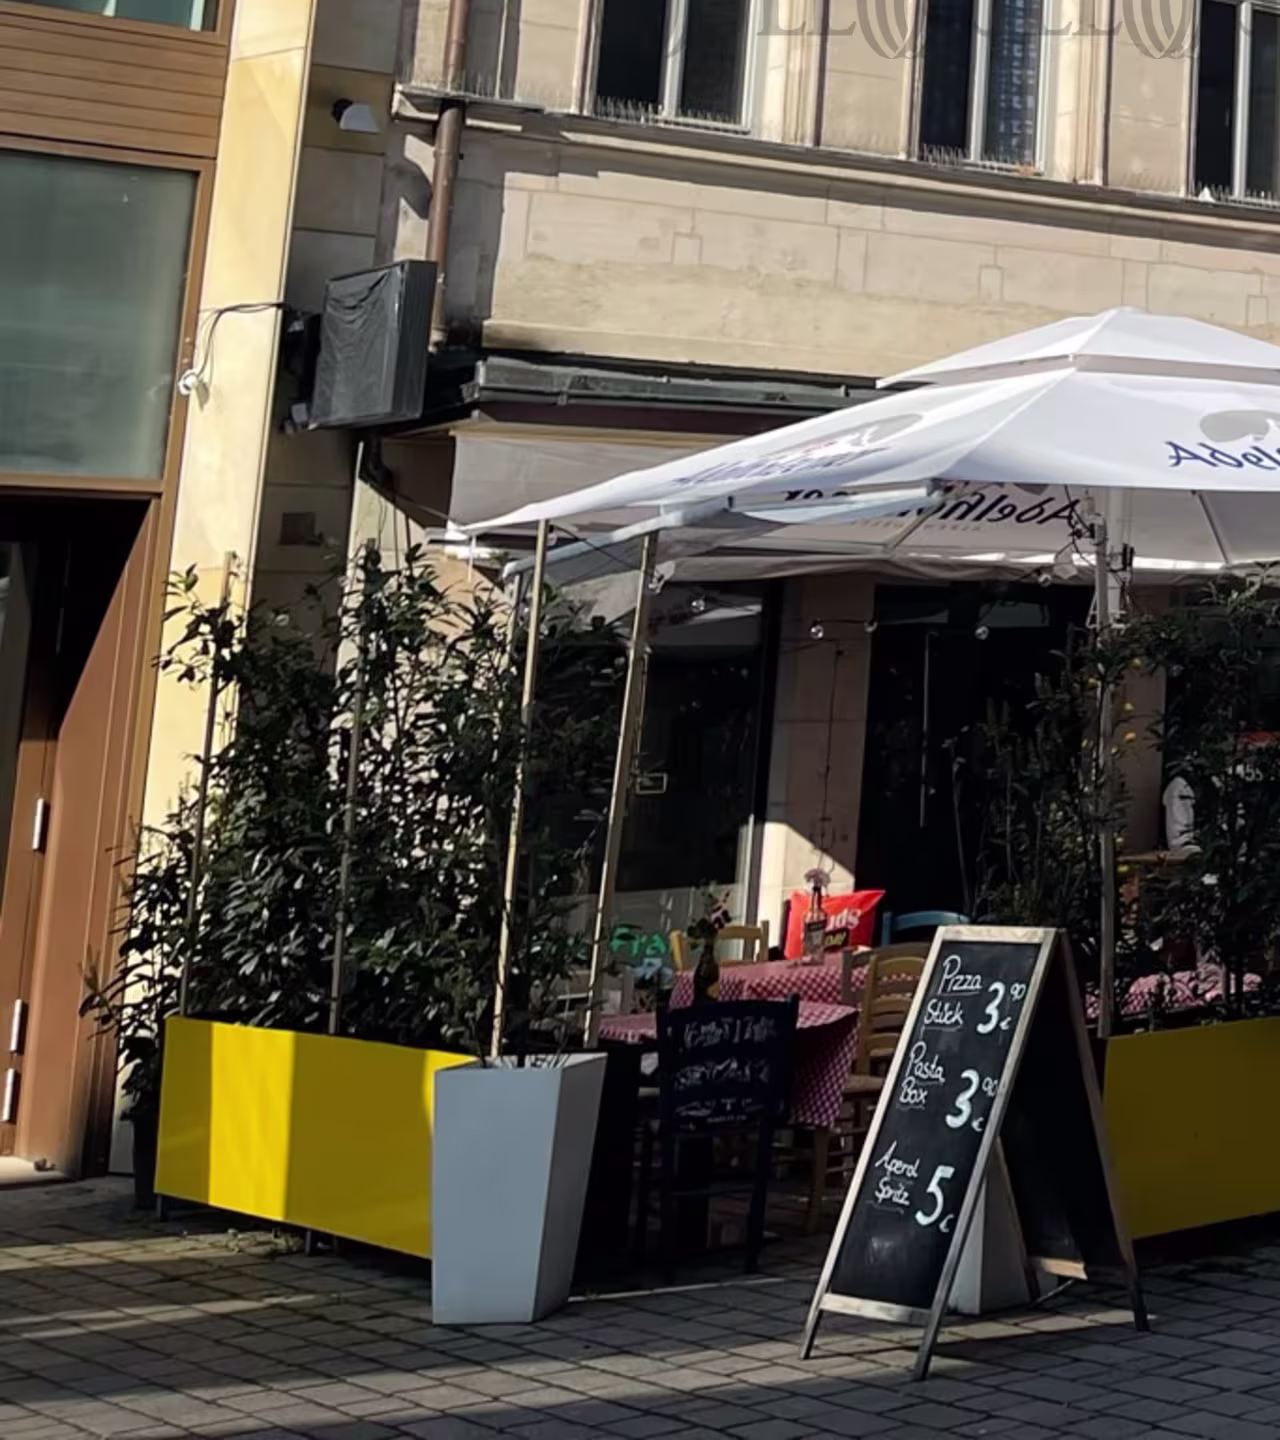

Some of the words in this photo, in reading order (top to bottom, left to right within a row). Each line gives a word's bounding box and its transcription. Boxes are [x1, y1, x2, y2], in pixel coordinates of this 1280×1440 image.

[937, 955, 983, 995] Pizza
[924, 998, 963, 1025] Stück
[906, 1041, 946, 1083] Pasta
[900, 1076, 929, 1104] Box
